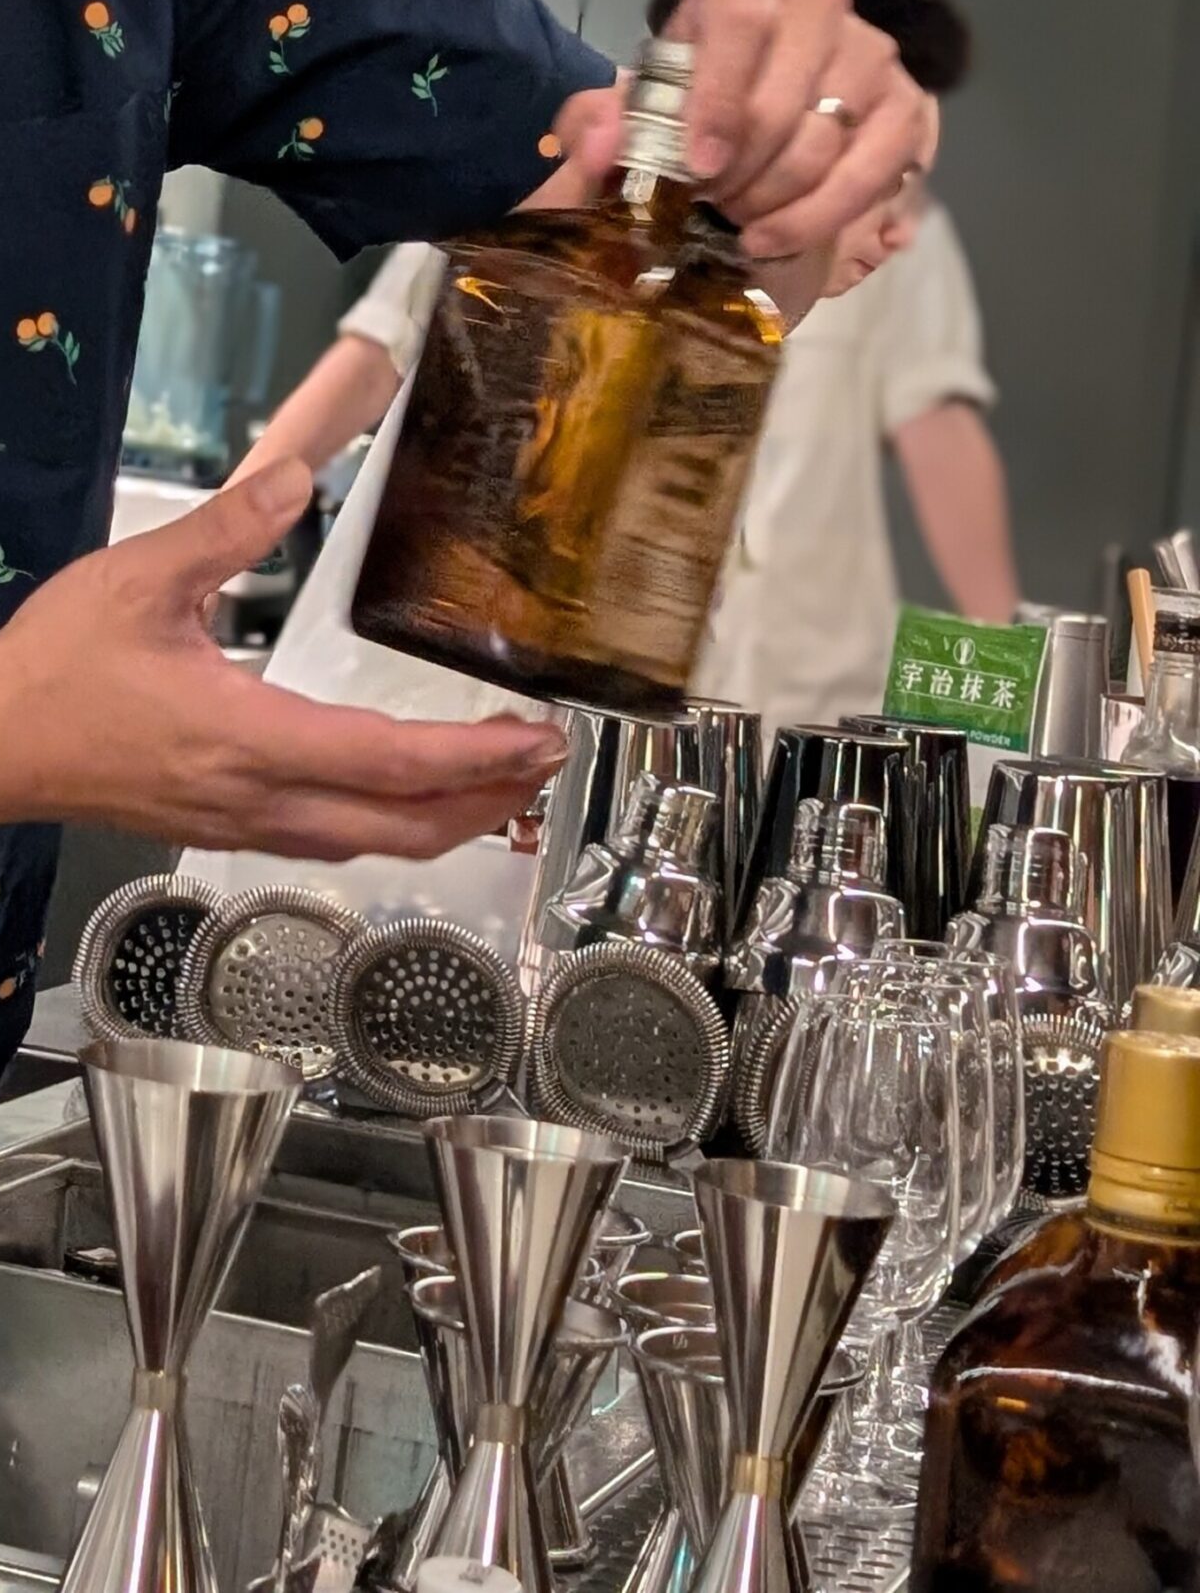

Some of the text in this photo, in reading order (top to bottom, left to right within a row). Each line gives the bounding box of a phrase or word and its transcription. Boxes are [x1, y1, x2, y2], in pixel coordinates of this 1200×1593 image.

[900, 663, 1017, 709] 宇治抹茶
[969, 729, 1011, 747] POWDER
